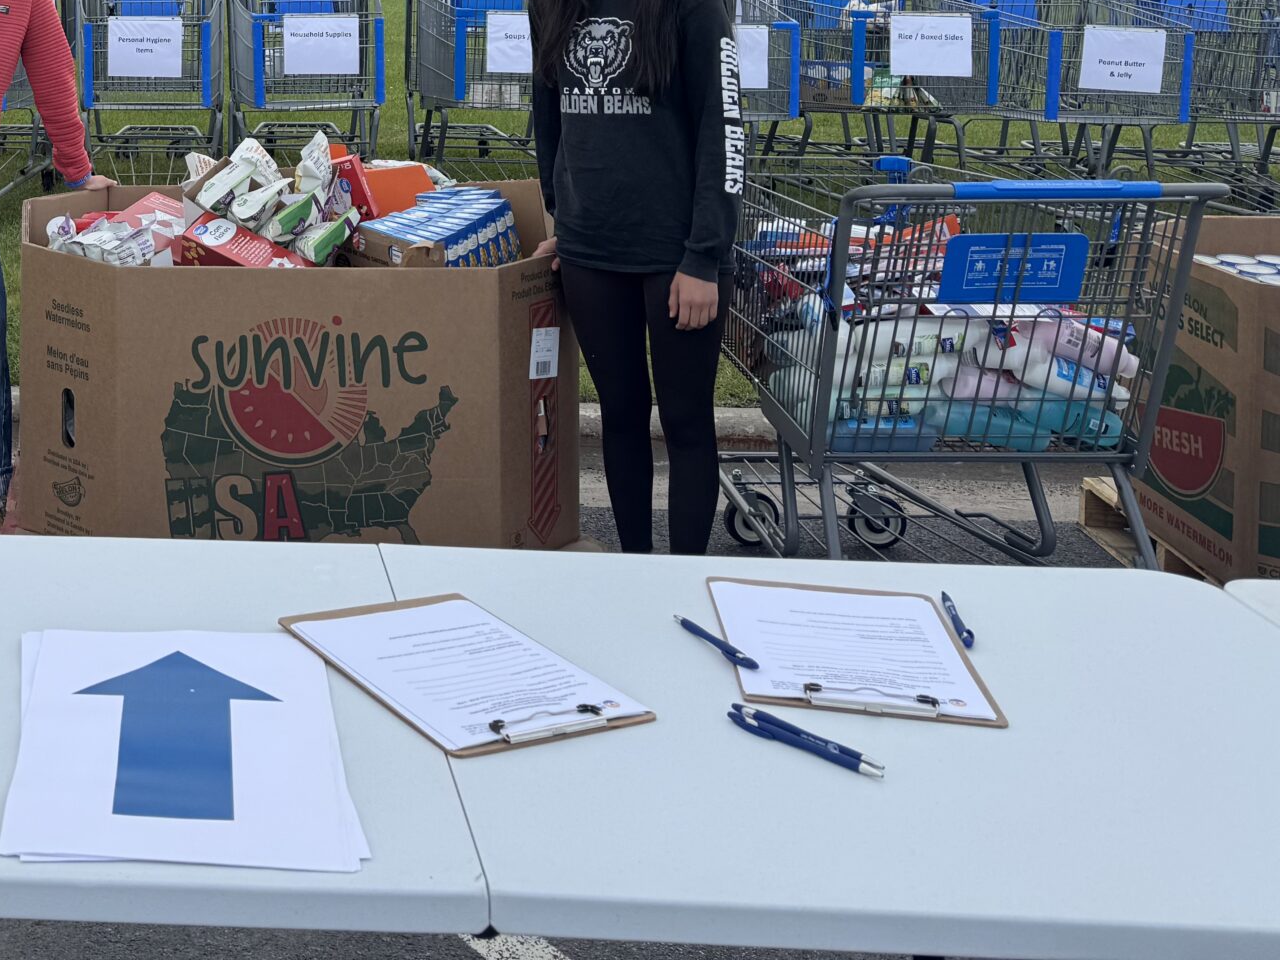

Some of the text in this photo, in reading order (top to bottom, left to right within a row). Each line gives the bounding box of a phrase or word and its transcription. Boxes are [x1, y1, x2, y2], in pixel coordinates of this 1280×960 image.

[325, 31, 352, 39] Supplies
[504, 32, 526, 40] Soups
[920, 33, 943, 41] Boxed
[1098, 58, 1146, 68] Peanut Butter
[1116, 71, 1133, 80] Jelly
[560, 94, 652, 114] OLDEN BEARS
[720, 37, 745, 195] GOLDEN BEARS
[51, 298, 84, 318] Seedless
[45, 309, 91, 333] Watermelons
[1187, 316, 1225, 349] SELECT
[46, 345, 89, 368] Melon d'eau
[46, 360, 63, 373] sans
[1154, 426, 1203, 459] FRESH
[165, 470, 307, 541] USA
[1139, 494, 1233, 567] MORE WATERMELON
